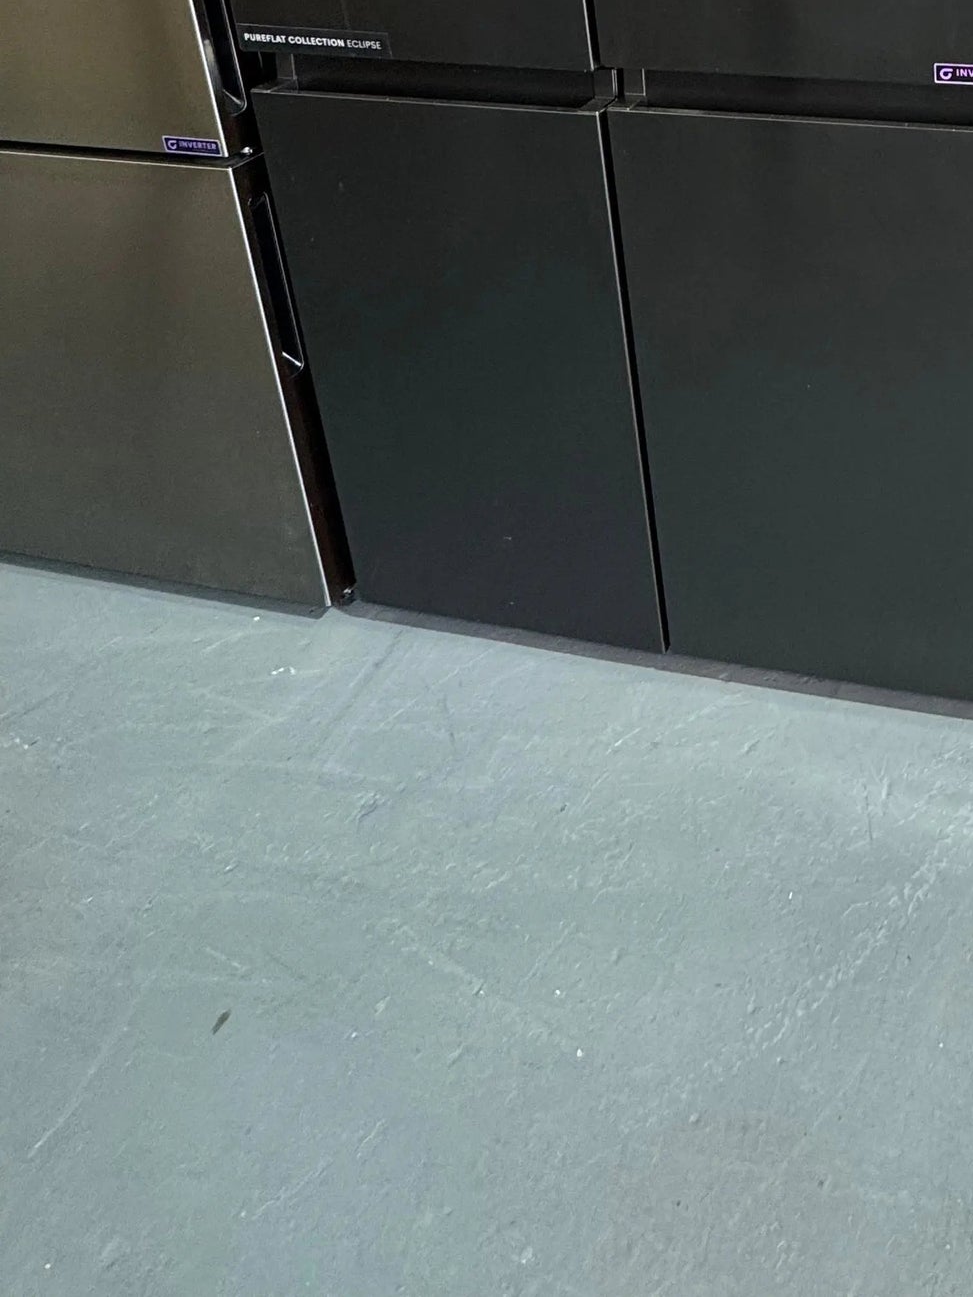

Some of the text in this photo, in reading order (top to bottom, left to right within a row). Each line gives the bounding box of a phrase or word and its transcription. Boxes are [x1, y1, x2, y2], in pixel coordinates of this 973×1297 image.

[243, 33, 382, 50] PUREFLAT COLLECTION ECLIPSE
[178, 140, 217, 149] INVERTER
